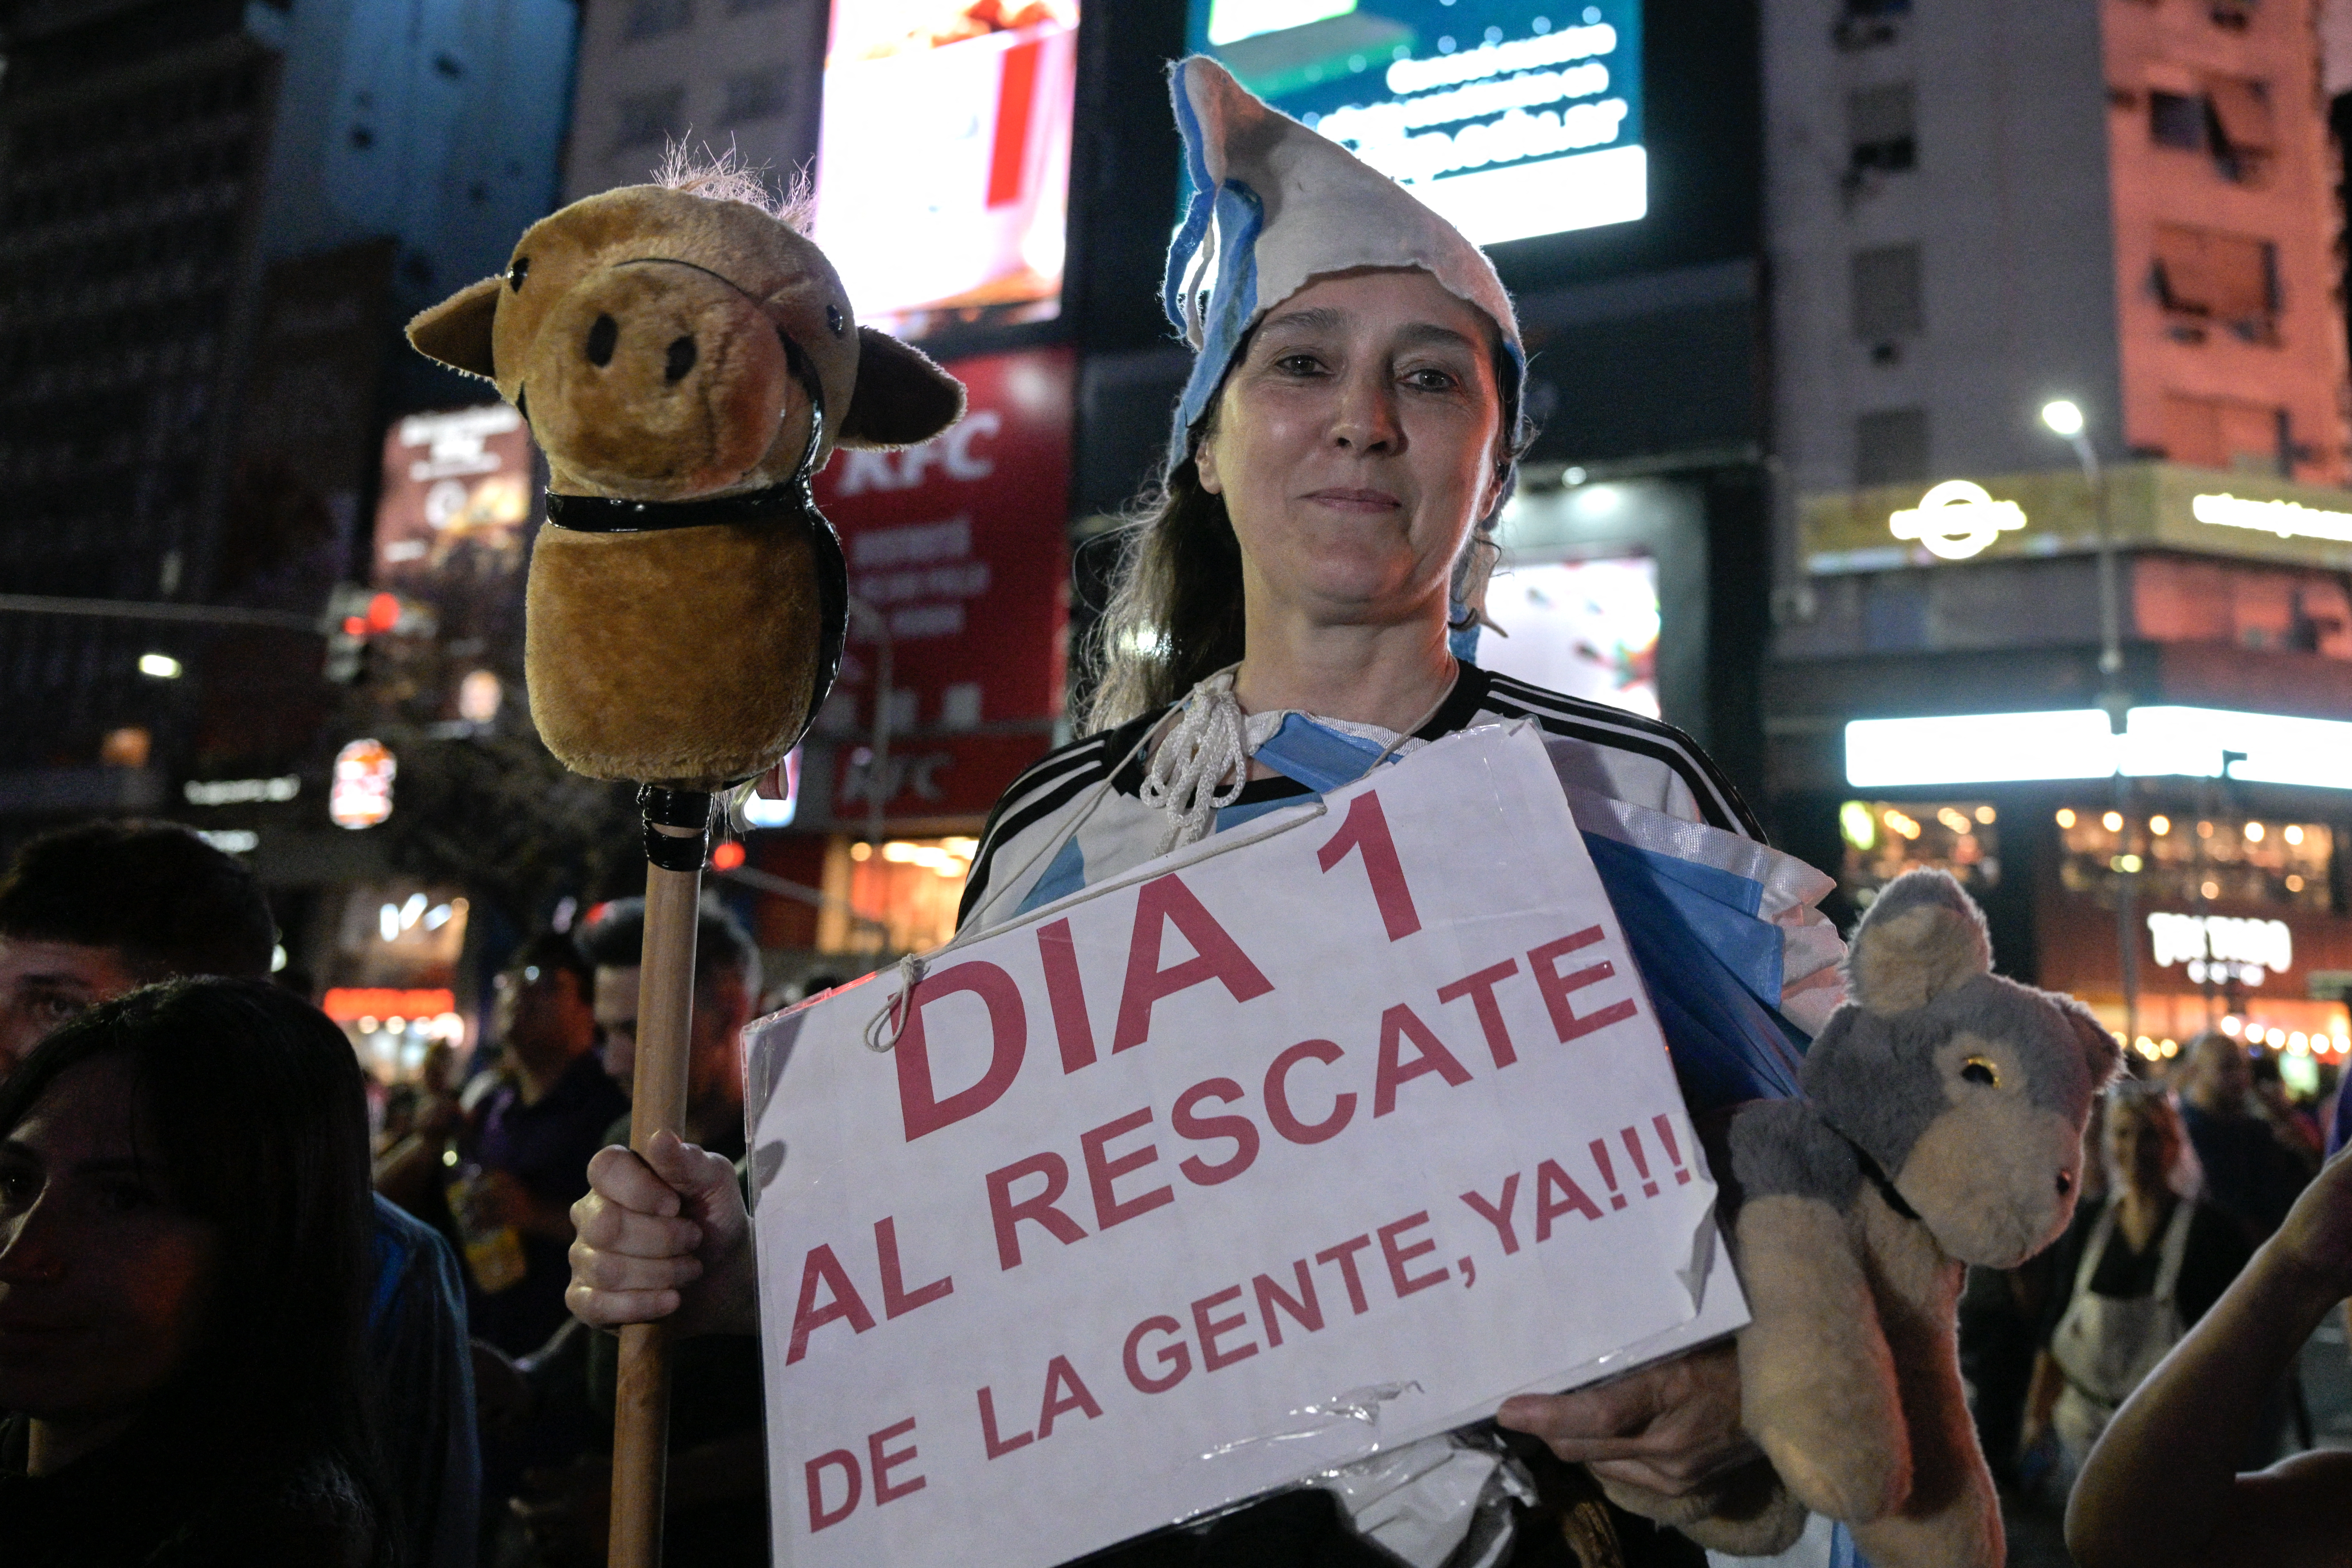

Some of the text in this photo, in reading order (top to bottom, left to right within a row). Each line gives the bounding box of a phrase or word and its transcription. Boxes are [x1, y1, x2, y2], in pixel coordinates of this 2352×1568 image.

[887, 789, 1422, 1142] DIA 1
[785, 924, 1638, 1366] AL RESCATE
[804, 1417, 927, 1533] DE
[977, 1355, 1103, 1460] LA
